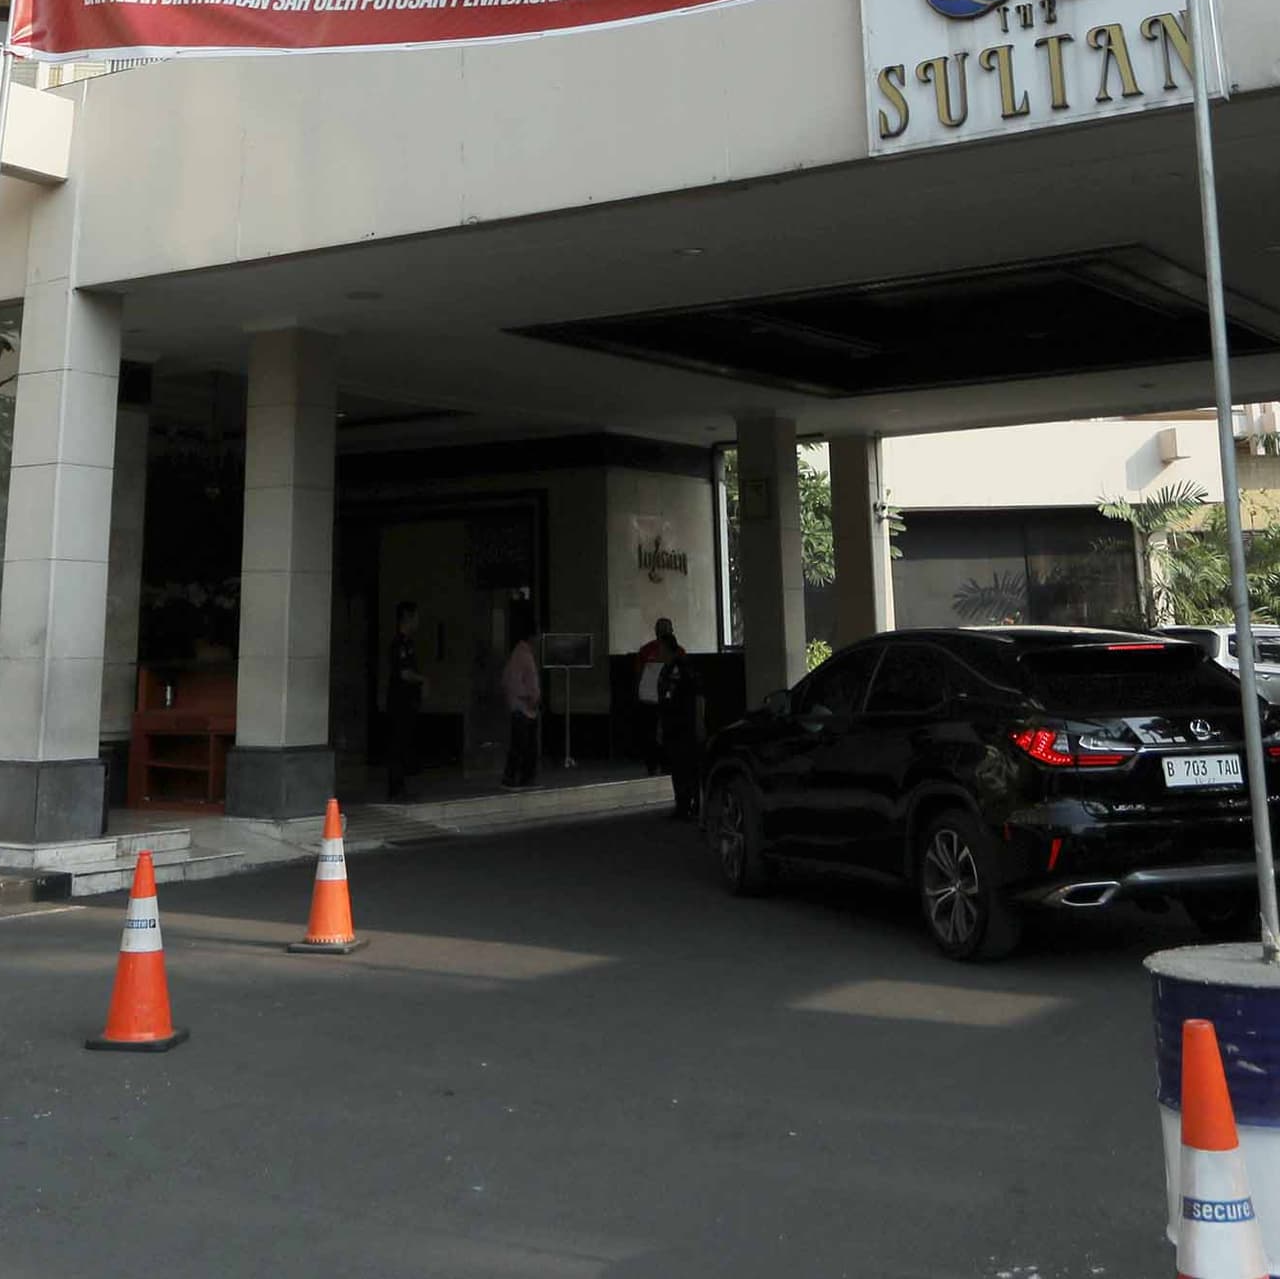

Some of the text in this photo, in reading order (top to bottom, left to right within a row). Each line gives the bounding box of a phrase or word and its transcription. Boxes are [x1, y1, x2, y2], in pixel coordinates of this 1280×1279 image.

[876, 10, 1195, 140] SULTAN
[1167, 759, 1239, 777] B 703 TAU
[1192, 1201, 1251, 1220] secure
